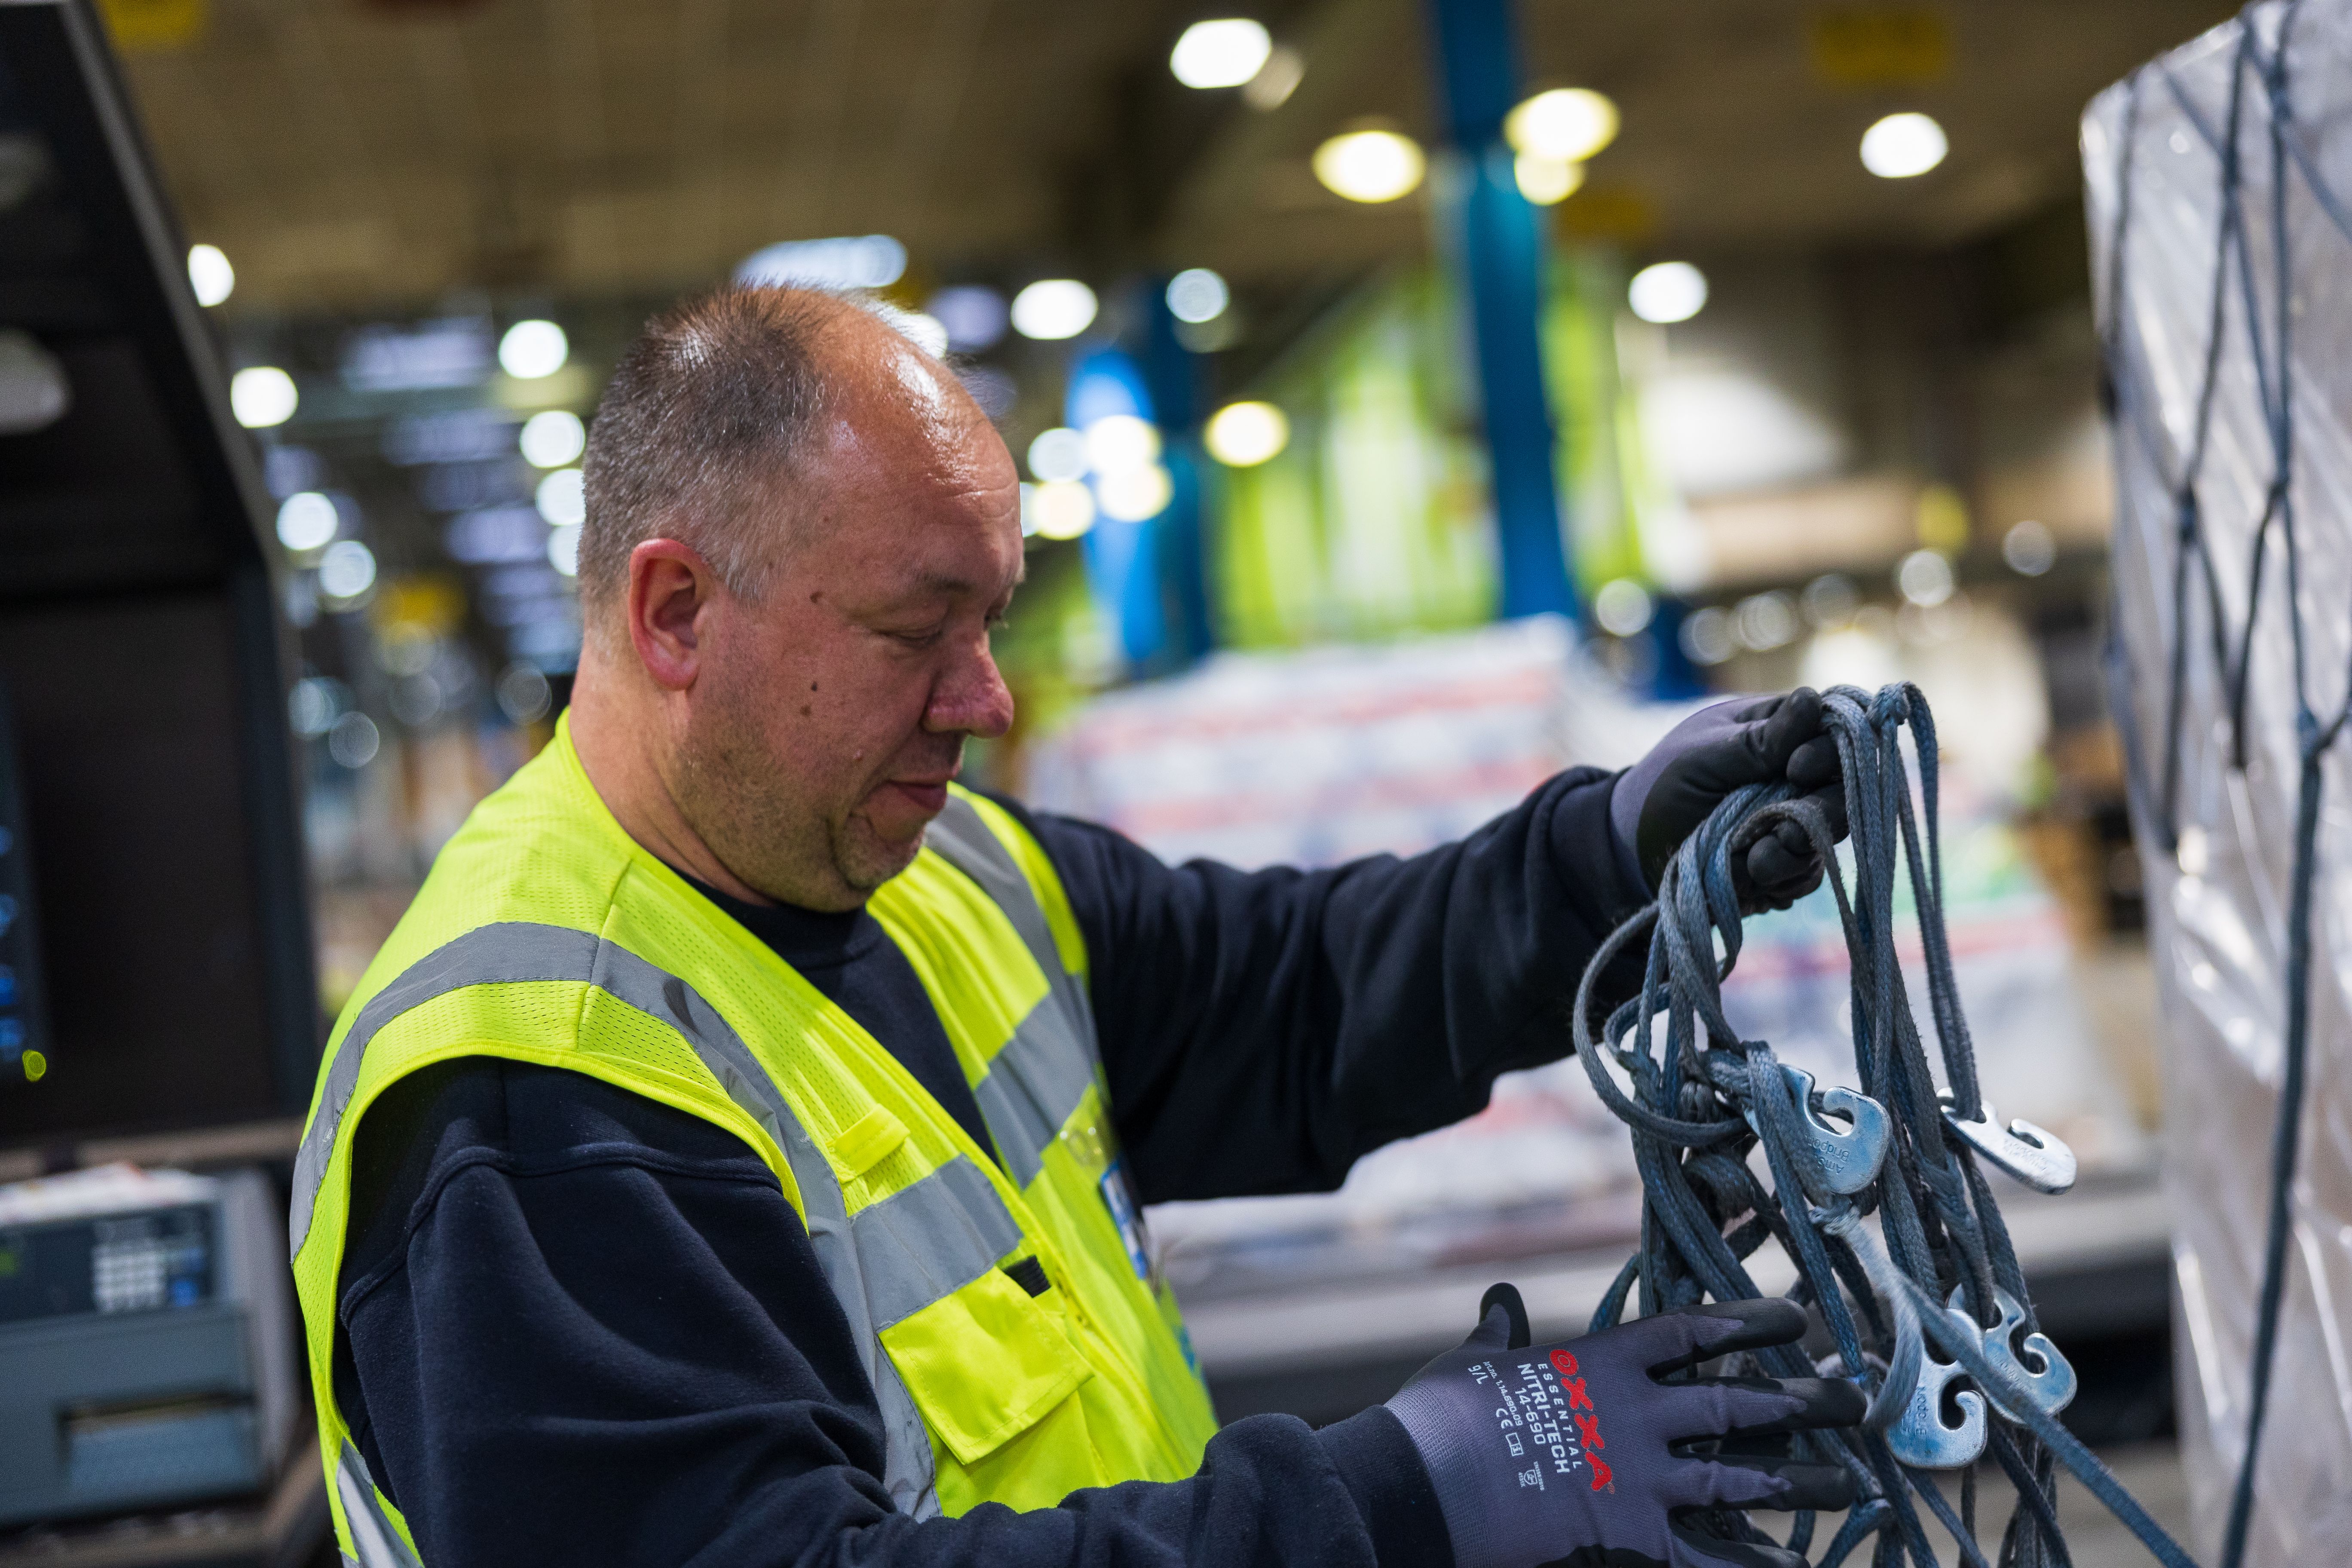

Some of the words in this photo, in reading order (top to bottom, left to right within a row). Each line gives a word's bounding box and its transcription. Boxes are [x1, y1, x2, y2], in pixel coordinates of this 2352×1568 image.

[1468, 1365, 1488, 1384] 9/L
[1496, 1380, 1523, 1426] 1.14.690.09
[1515, 1387, 1546, 1445] 14-690
[1517, 1363, 1570, 1473] NITRI-TECH
[1537, 1363, 1582, 1469] ESSENTIAL
